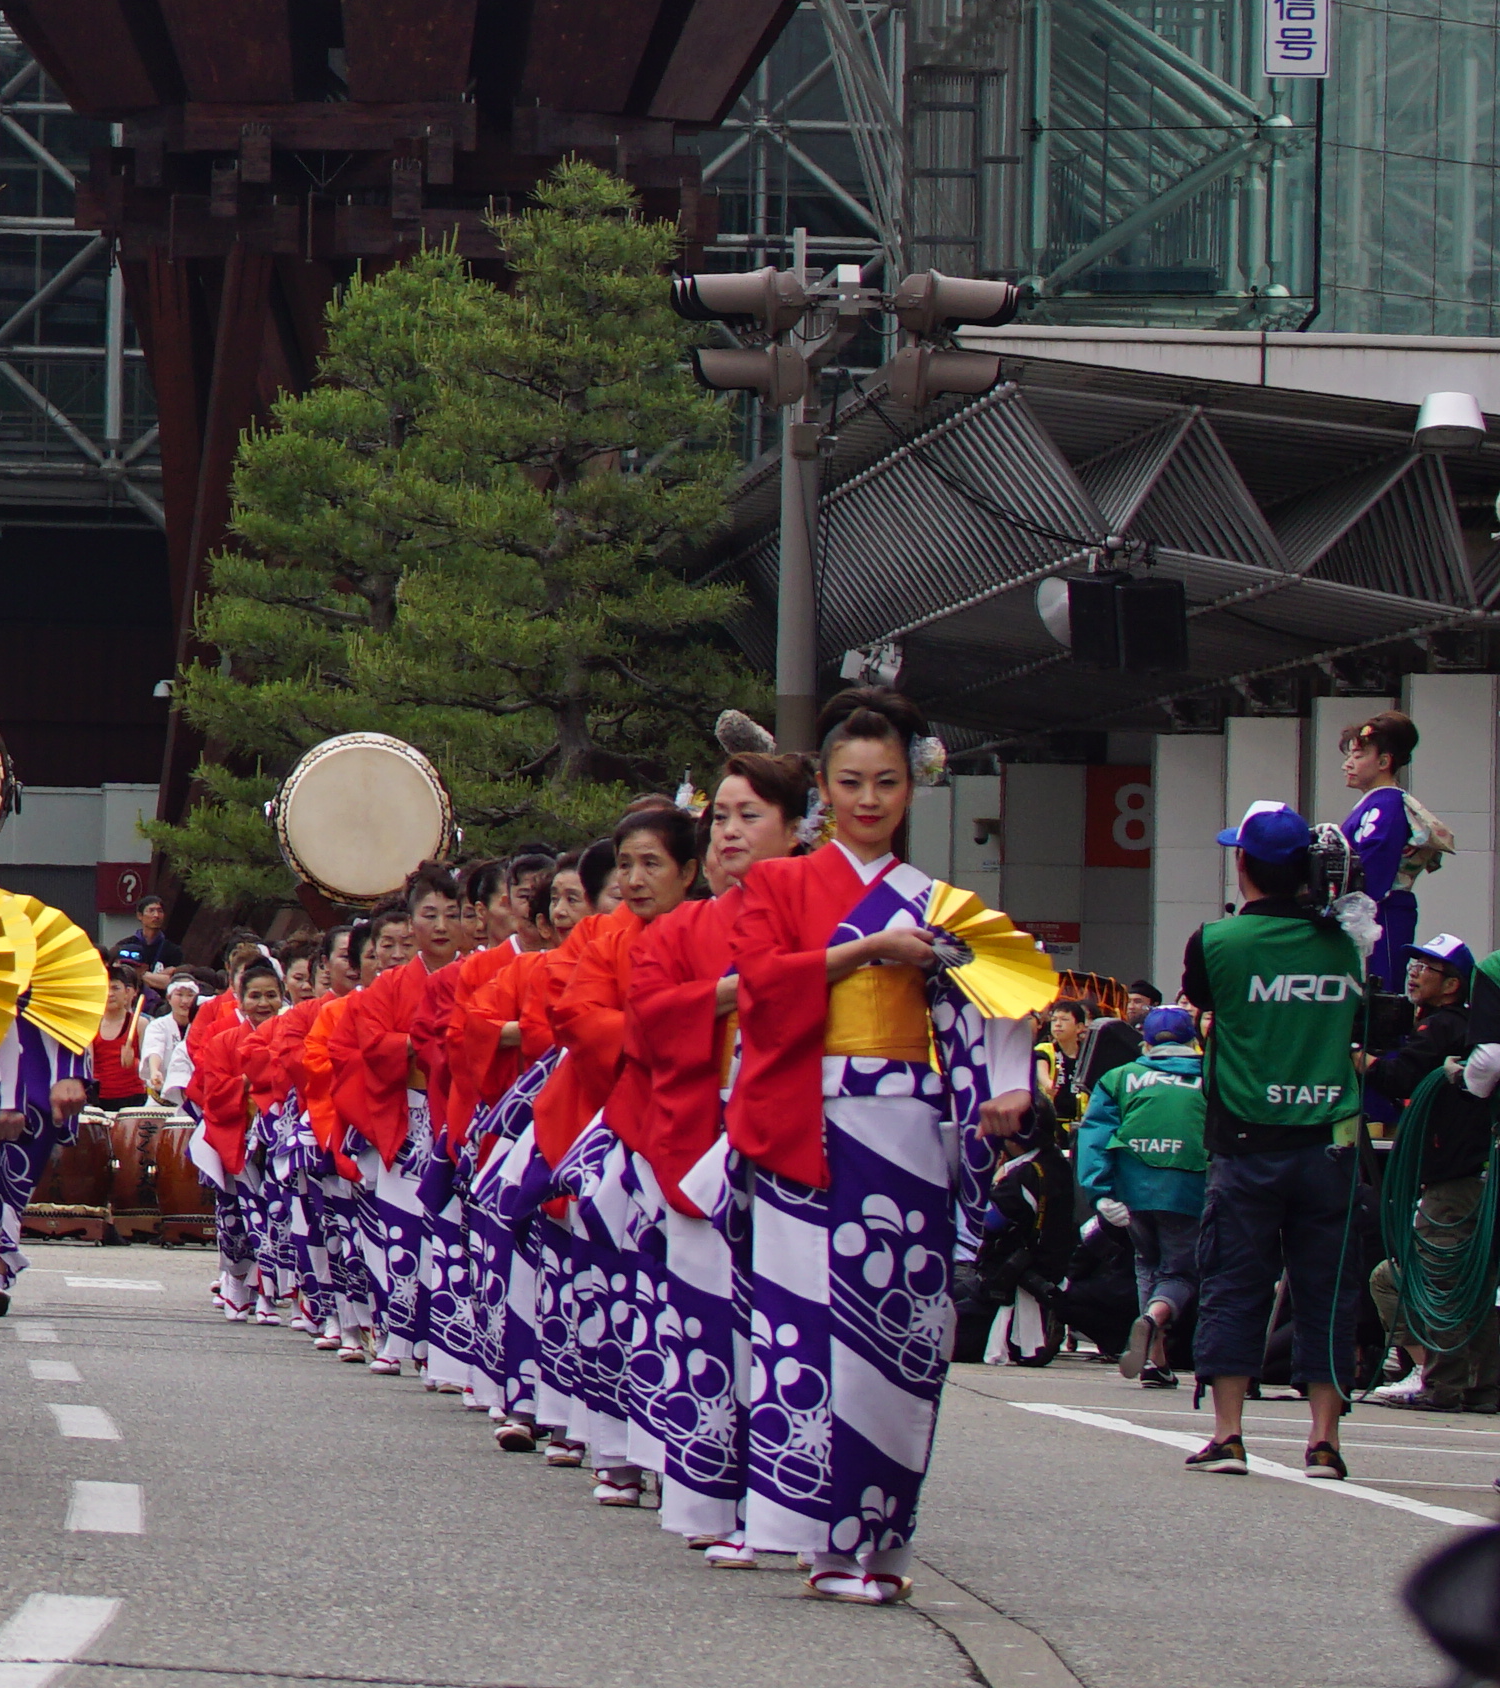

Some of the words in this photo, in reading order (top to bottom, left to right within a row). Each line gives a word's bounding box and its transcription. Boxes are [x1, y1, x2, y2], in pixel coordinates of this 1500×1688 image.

[1111, 782, 1152, 851] 8
[1266, 1084, 1342, 1105] STAFF
[1128, 1138, 1184, 1154] STAFF
